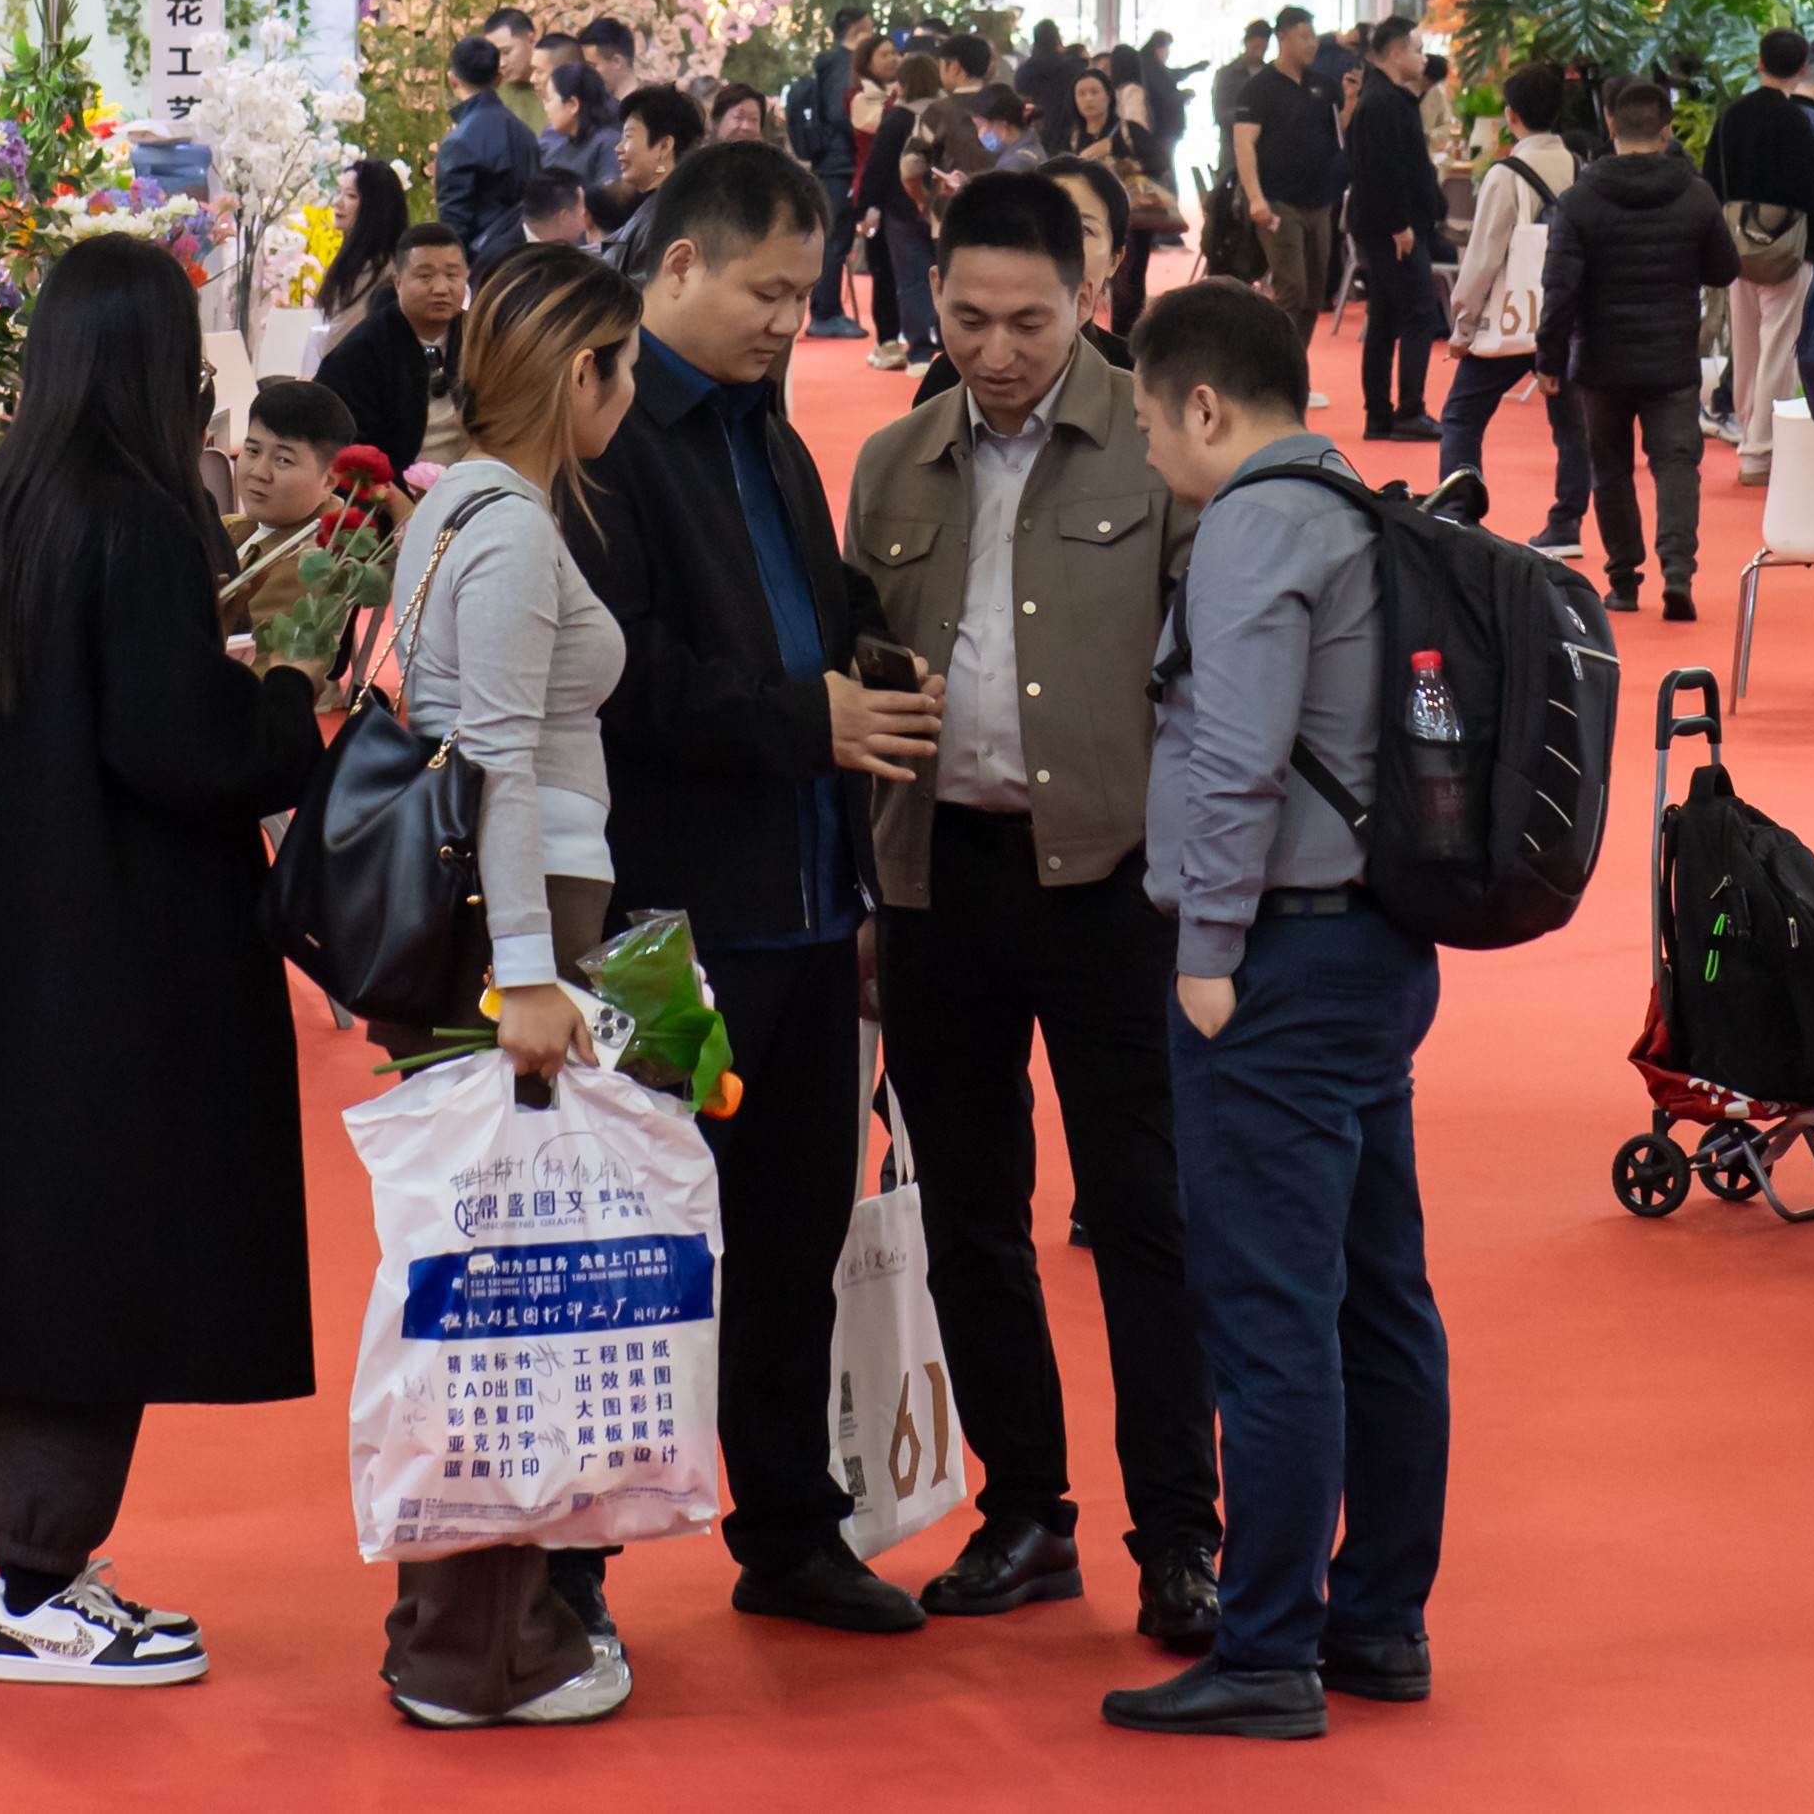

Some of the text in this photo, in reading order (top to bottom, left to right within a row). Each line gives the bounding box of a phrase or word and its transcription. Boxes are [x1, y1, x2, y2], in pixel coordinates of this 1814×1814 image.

[447, 1353, 532, 1374] 精装标书
[573, 1338, 671, 1366] 工程图纸
[574, 1365, 672, 1393] 出效果图
[447, 1404, 534, 1427] 彩色复印
[576, 1392, 674, 1420] 大图彩扫
[447, 1431, 536, 1454] 亚克力字
[577, 1419, 675, 1446] 展板展架
[579, 1445, 679, 1473] 广告设计
